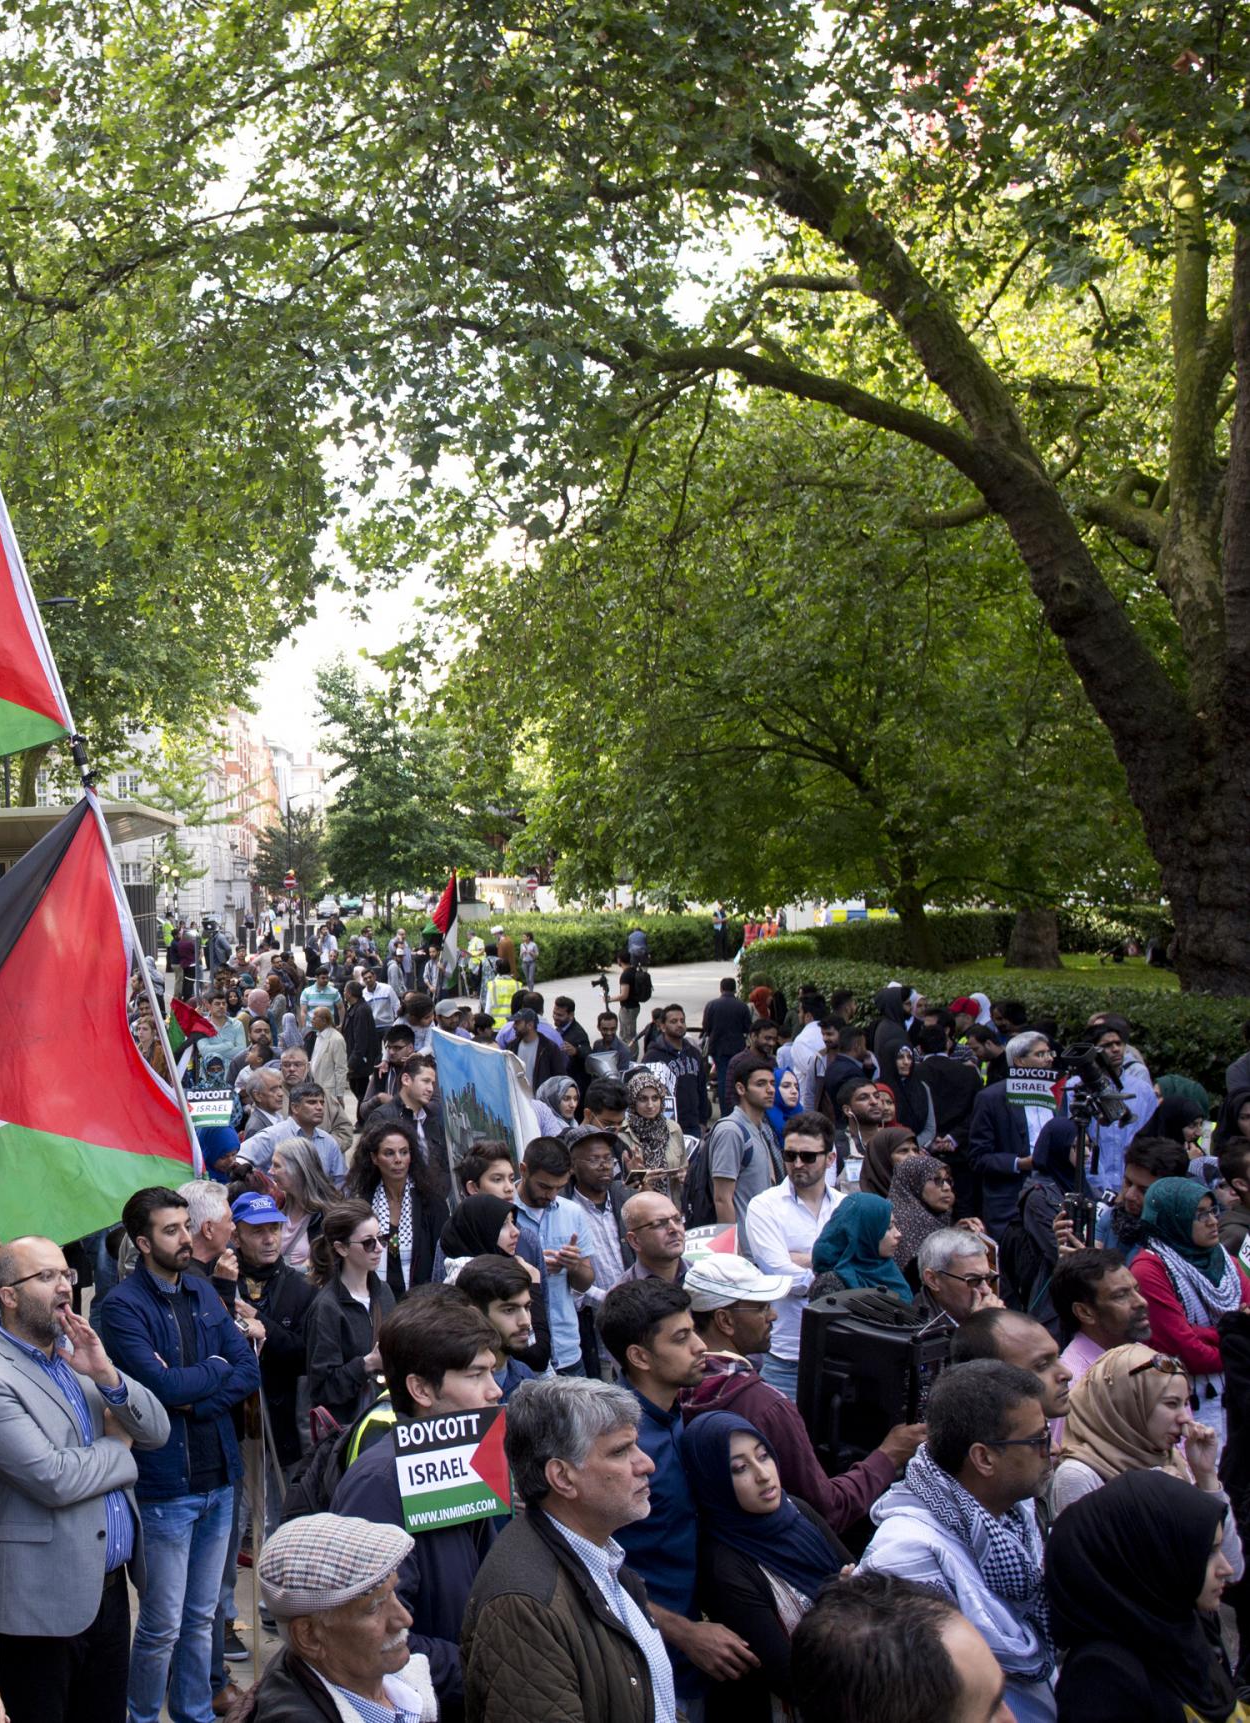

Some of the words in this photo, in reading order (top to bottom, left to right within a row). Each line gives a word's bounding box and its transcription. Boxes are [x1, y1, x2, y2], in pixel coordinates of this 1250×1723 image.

[1009, 1068, 1058, 1080] BOYCOTT
[1012, 1083, 1048, 1092] ISRAEL
[187, 1089, 231, 1100] BOYCOTT
[196, 1105, 228, 1113] ISRAEL
[396, 1413, 481, 1448] BOYCOTT
[408, 1457, 468, 1487] ISRAEL
[408, 1498, 498, 1526] WWW.INMINDS.COM
